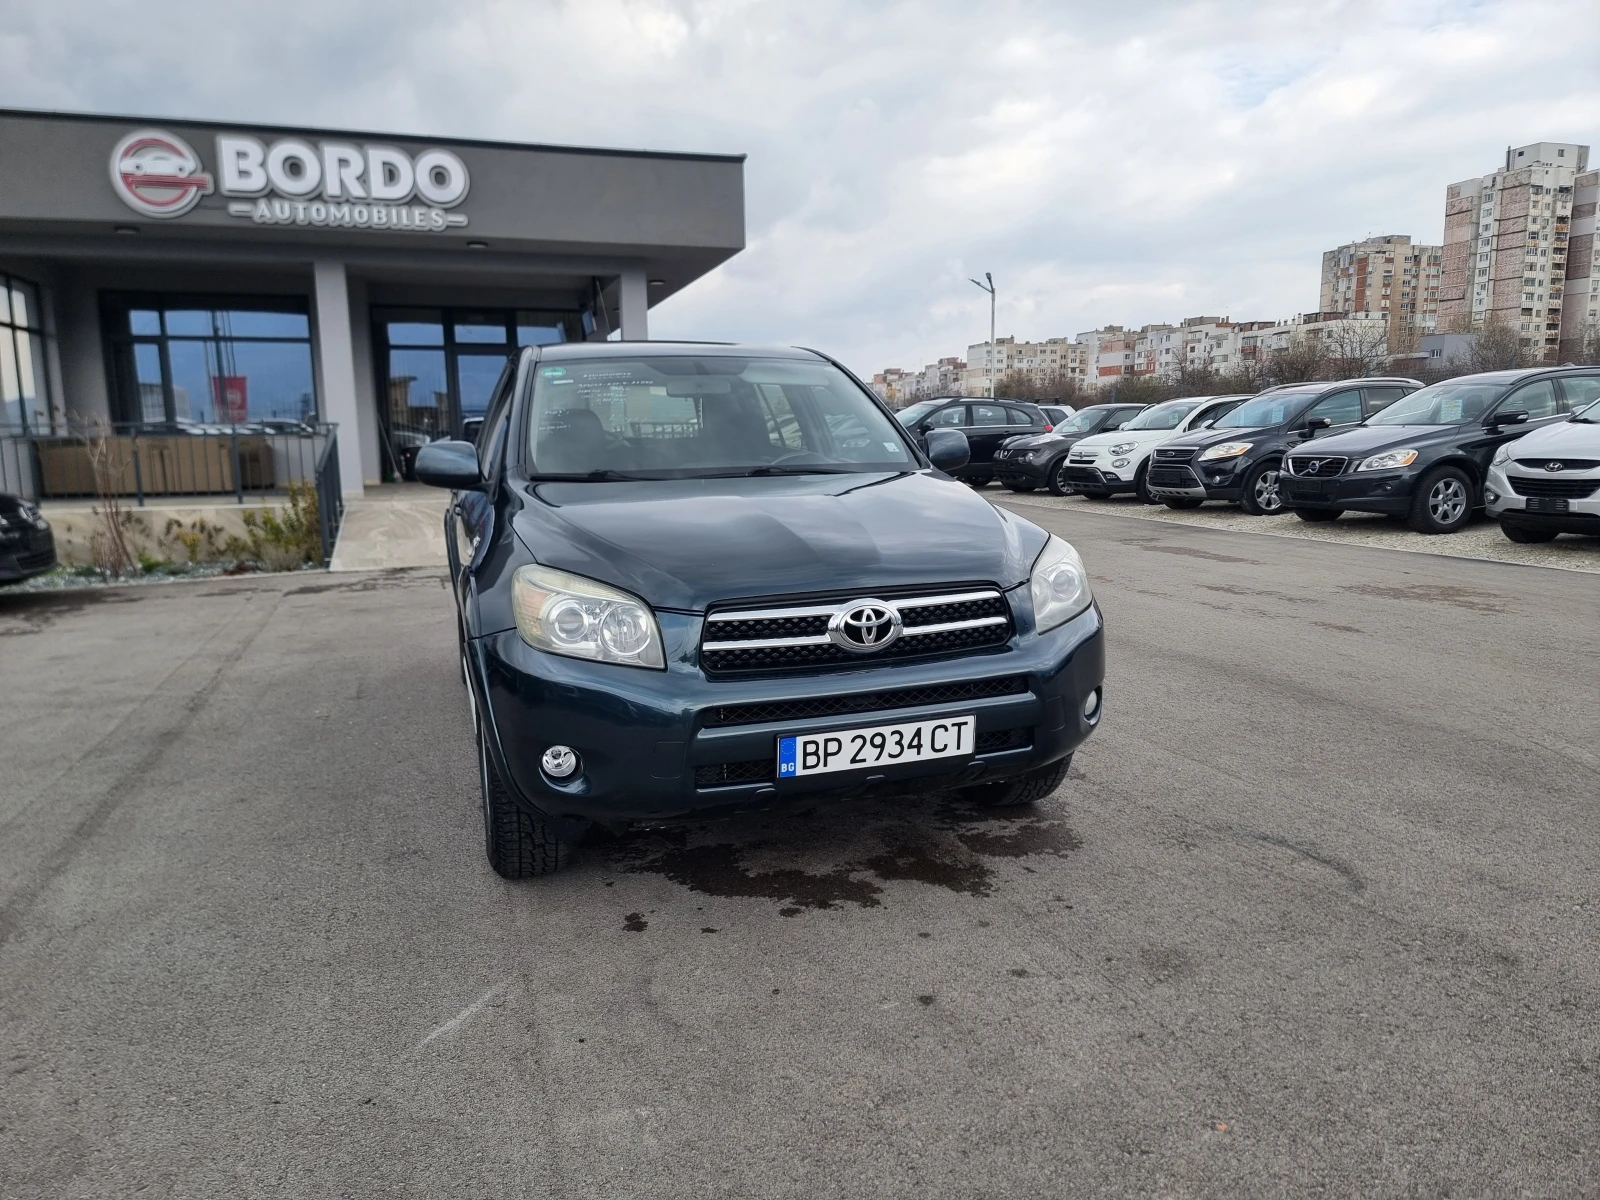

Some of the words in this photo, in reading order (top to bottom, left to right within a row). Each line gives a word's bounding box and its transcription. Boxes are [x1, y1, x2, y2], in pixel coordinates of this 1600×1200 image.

[218, 136, 468, 205] BORDO
[256, 201, 444, 228] AUTOMOBILES
[802, 737, 843, 770] BP
[849, 727, 924, 765] 2934
[930, 721, 969, 753] CT
[781, 762, 795, 773] BG
